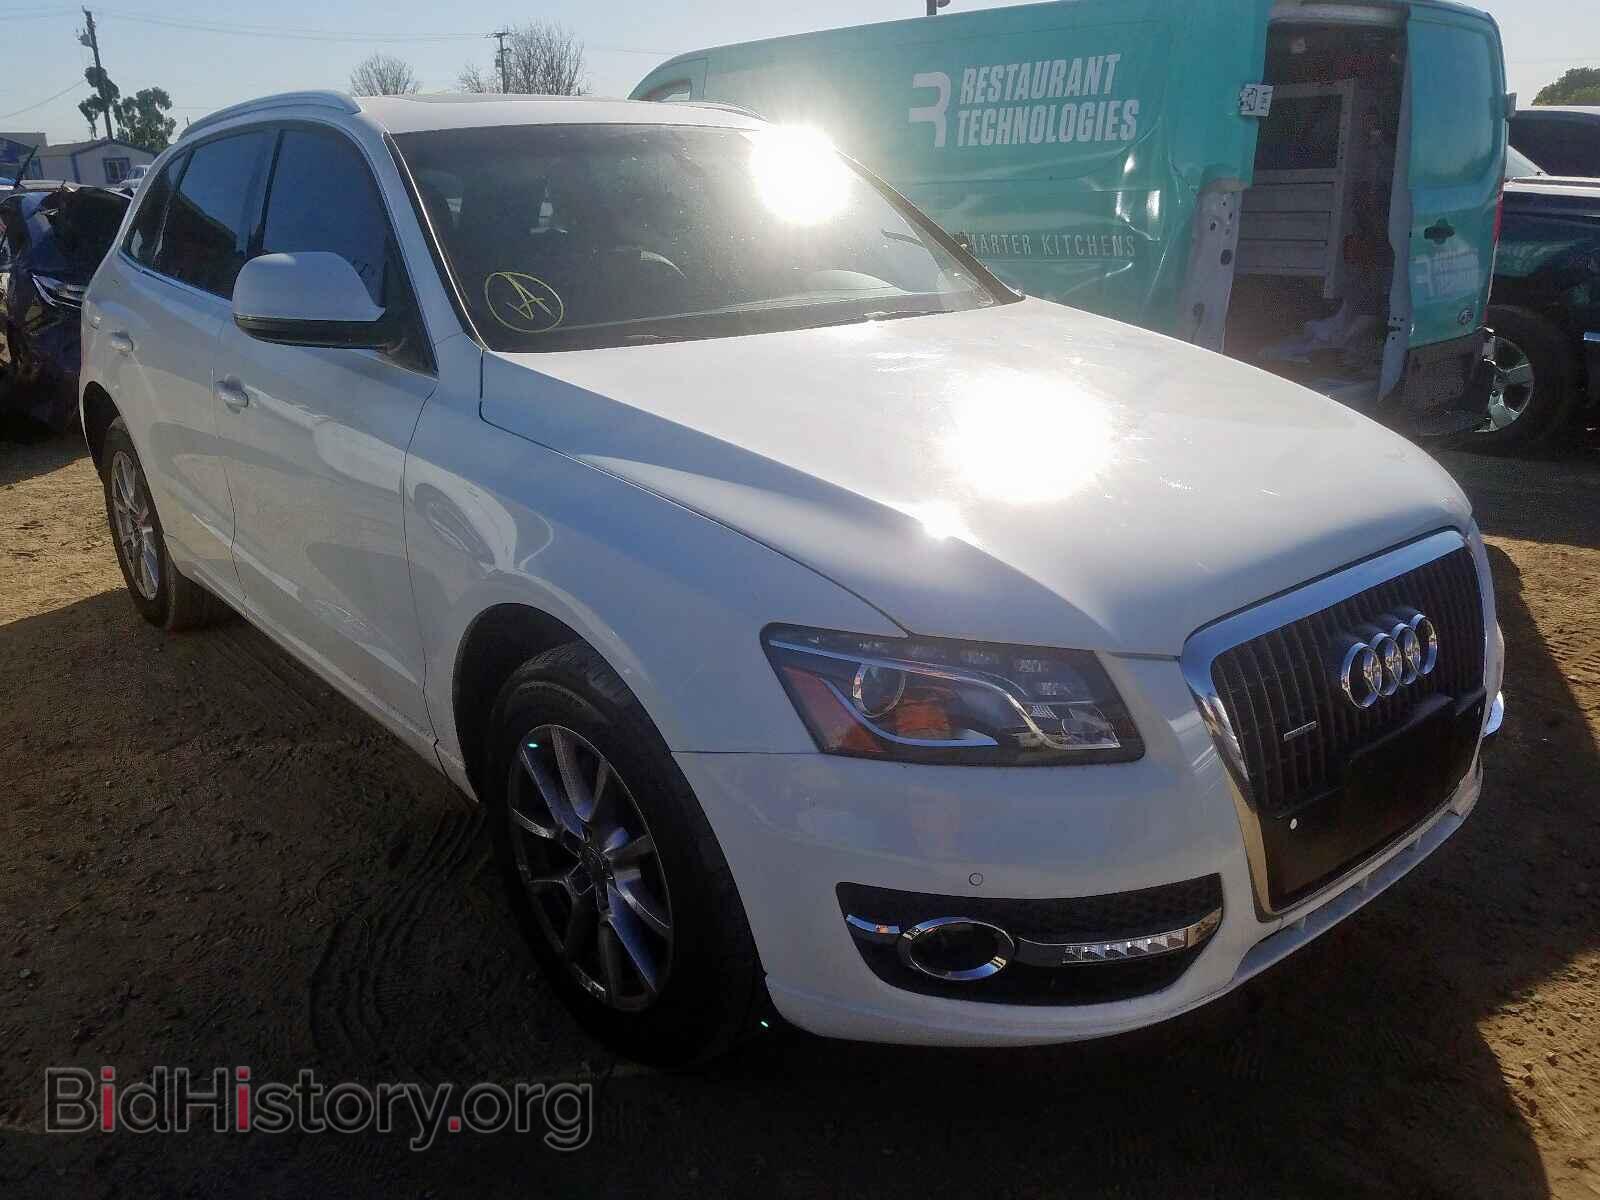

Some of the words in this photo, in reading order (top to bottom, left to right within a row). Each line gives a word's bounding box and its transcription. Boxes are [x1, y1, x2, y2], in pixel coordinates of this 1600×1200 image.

[960, 54, 1120, 104] RESTAURANT
[957, 100, 1139, 146] TECHNOLOGIES
[1041, 235, 1136, 257] KITCHENS
